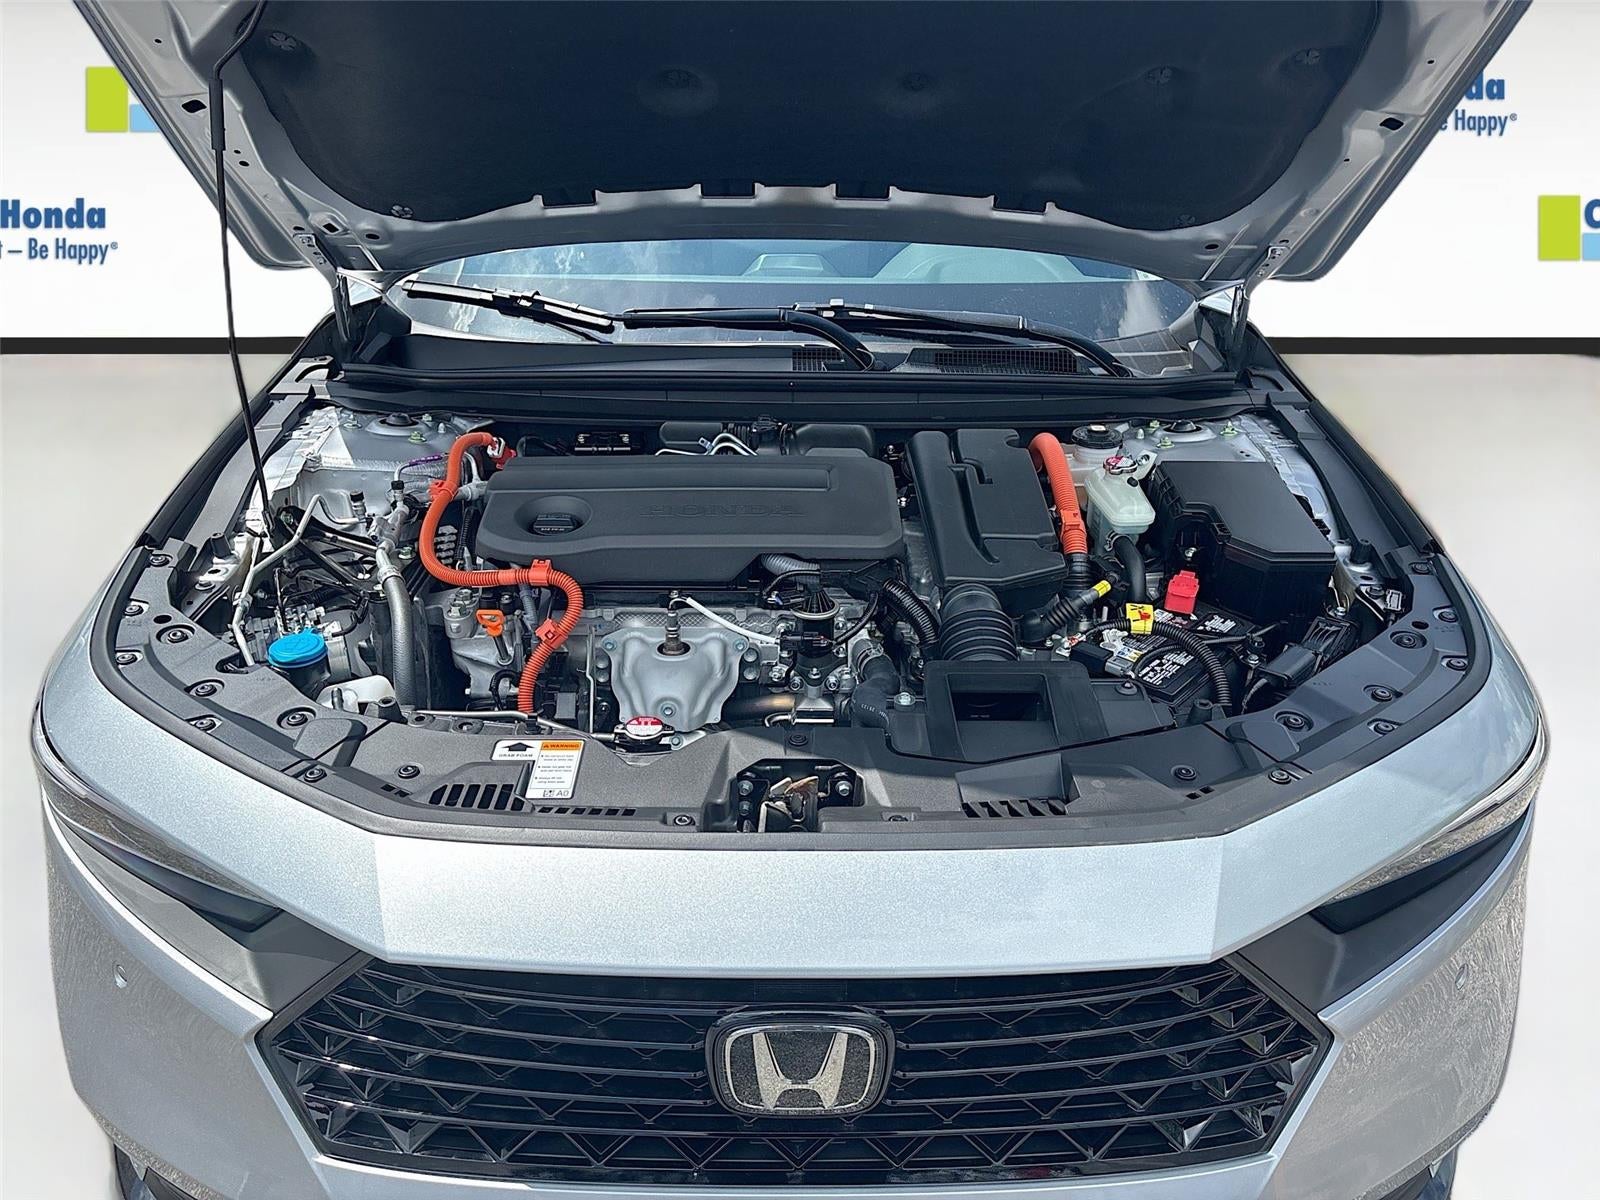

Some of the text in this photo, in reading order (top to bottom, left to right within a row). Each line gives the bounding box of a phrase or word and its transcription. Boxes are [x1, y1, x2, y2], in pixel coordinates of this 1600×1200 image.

[0, 198, 106, 229] Honda
[28, 238, 49, 260] Be
[640, 504, 807, 518] HONDA
